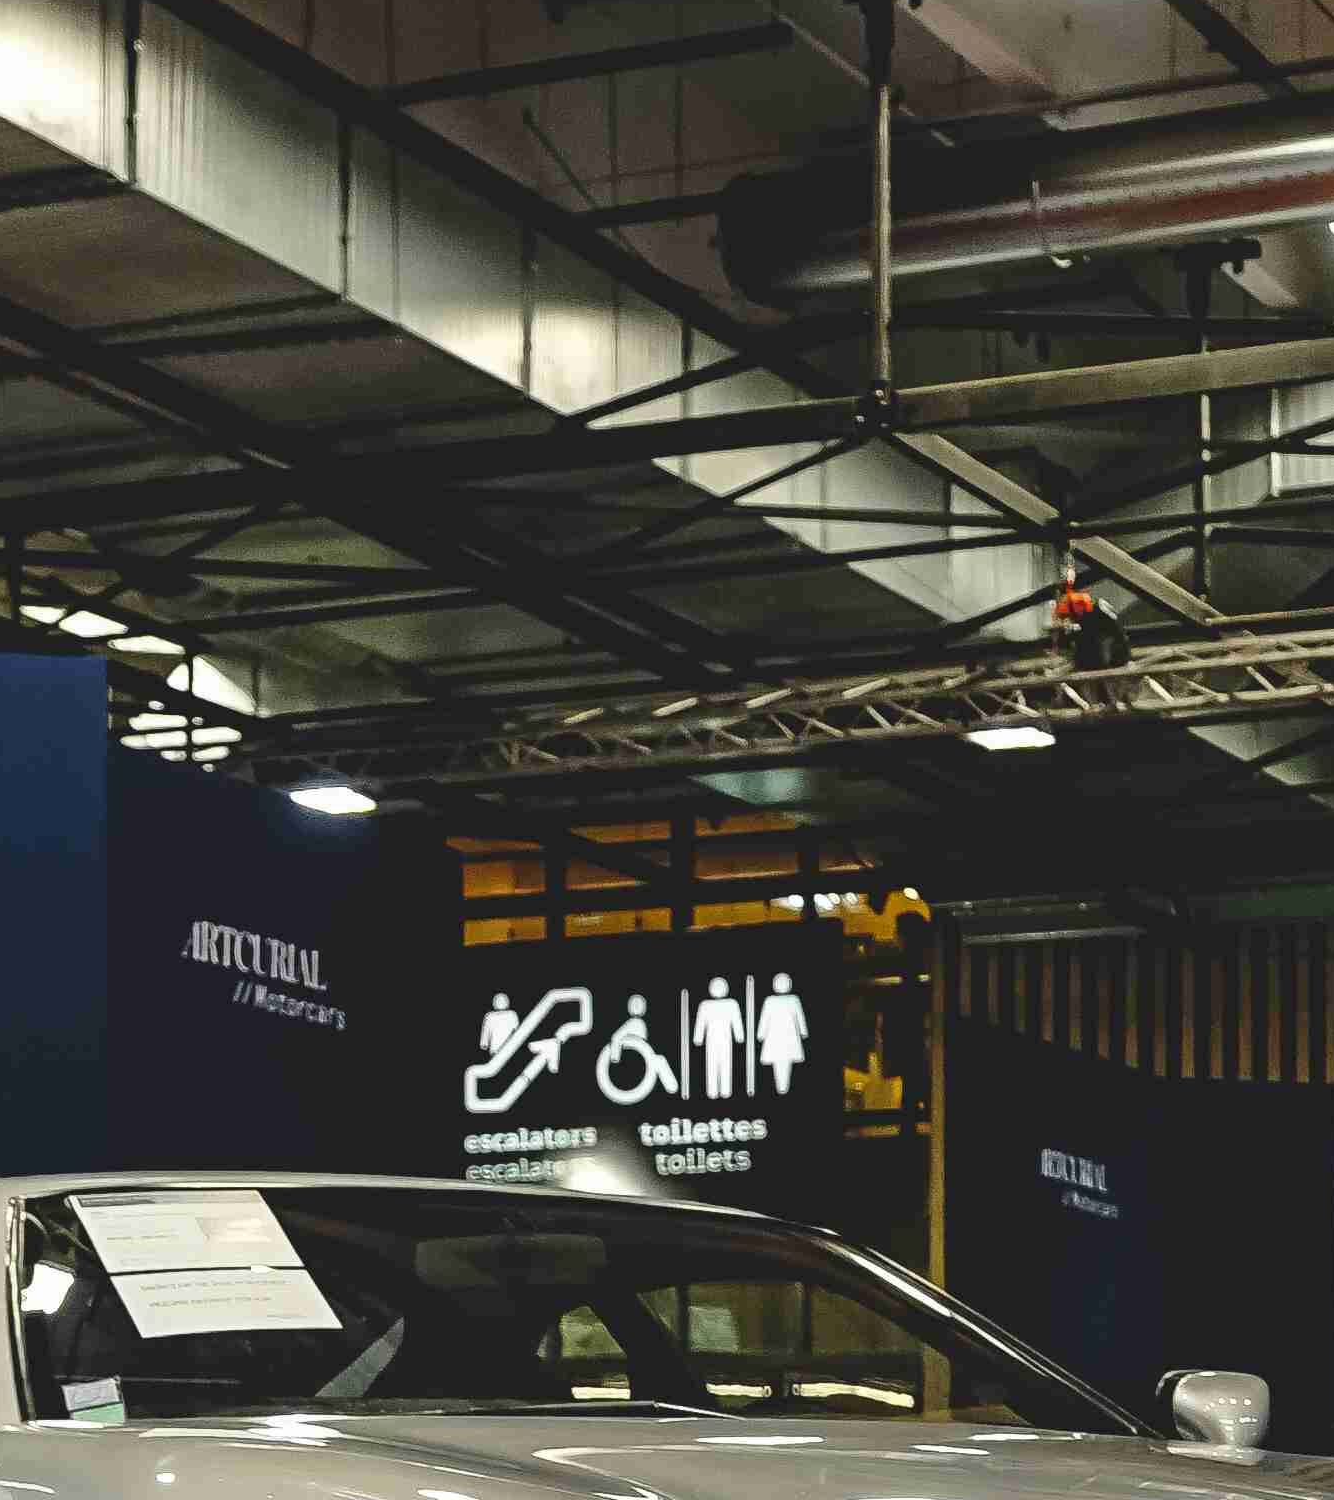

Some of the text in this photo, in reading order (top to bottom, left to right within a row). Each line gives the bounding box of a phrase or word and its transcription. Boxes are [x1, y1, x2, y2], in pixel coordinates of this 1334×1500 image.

[181, 920, 328, 992] ARTCURIAL
[464, 1126, 597, 1154] escalators
[638, 1117, 767, 1147] toilettes
[654, 1148, 752, 1176] toilets
